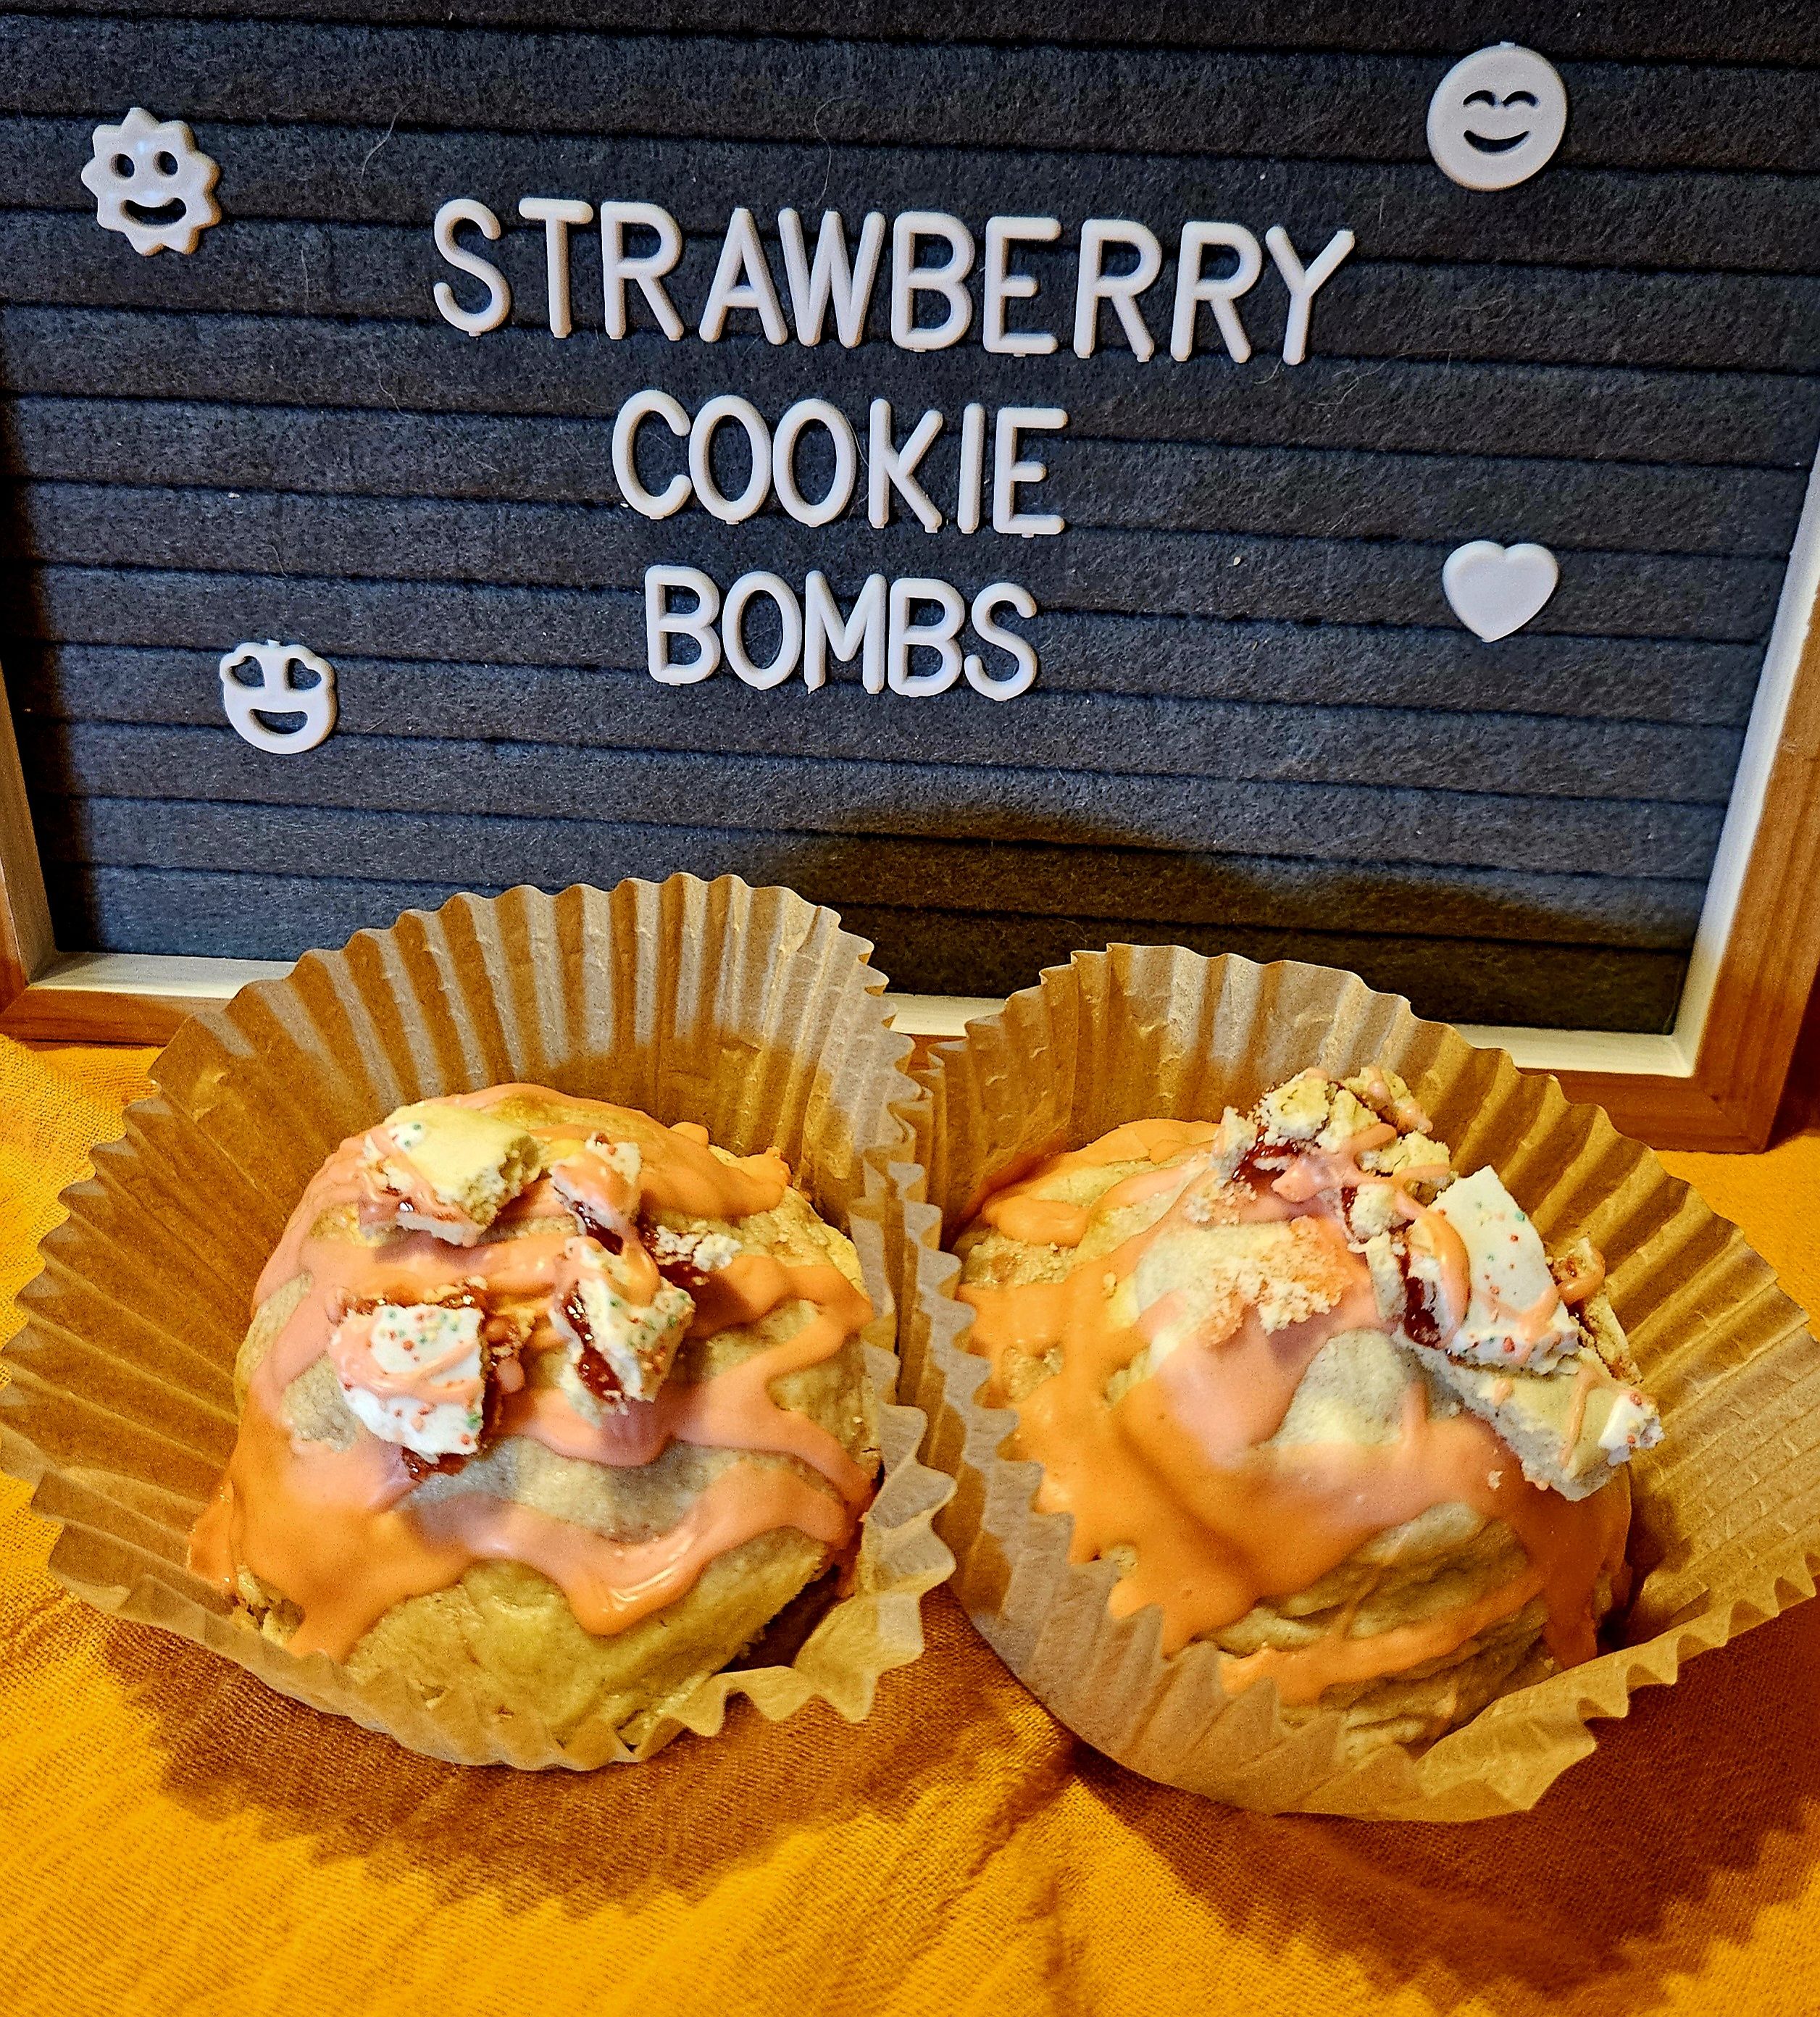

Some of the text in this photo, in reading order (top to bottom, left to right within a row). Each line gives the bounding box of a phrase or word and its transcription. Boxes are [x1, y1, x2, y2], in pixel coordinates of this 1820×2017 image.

[433, 198, 1355, 365] STRAWBERRY
[611, 389, 1069, 538] COOKIE
[644, 564, 1038, 701] BOMBS
